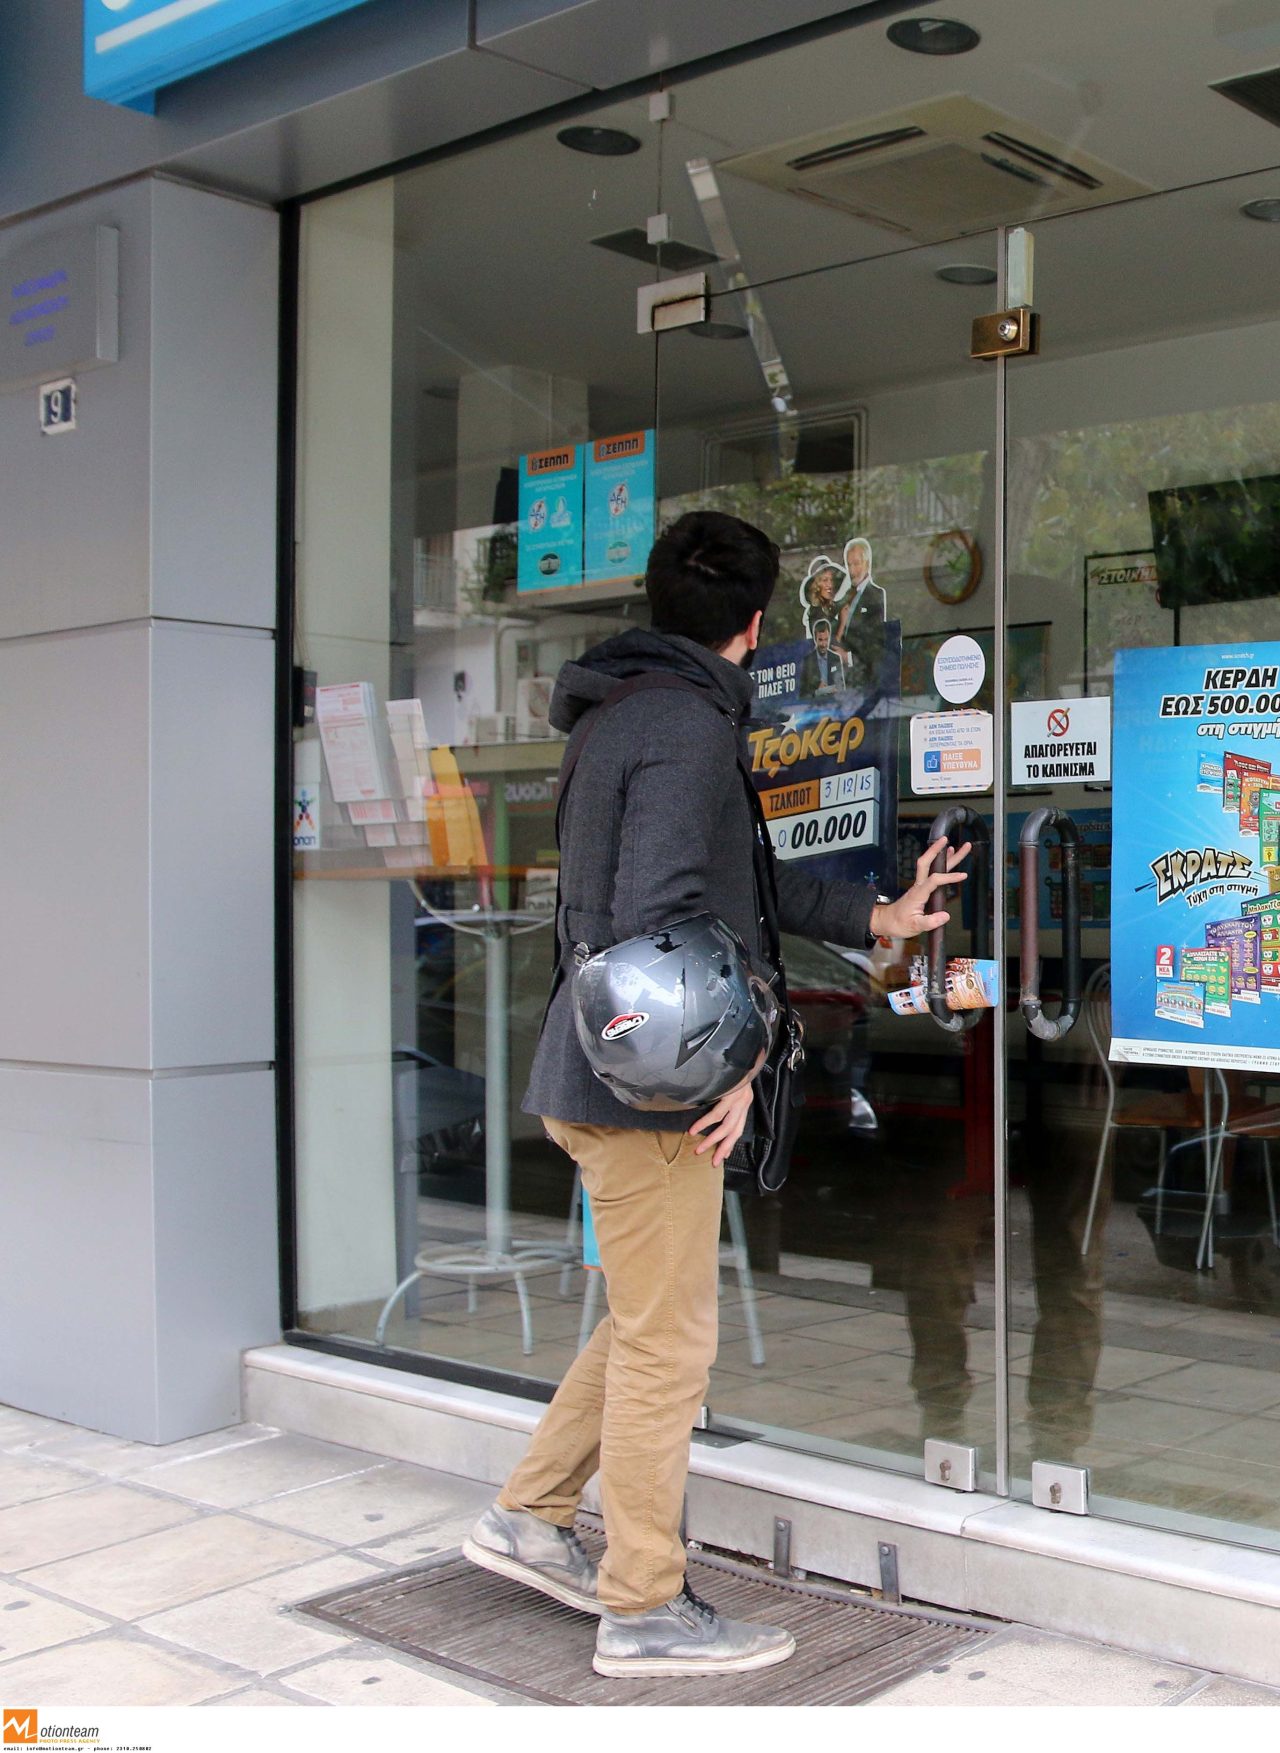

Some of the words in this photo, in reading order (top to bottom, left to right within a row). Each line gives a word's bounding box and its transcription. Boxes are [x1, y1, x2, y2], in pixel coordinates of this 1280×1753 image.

[50, 390, 62, 423] 9
[1099, 565, 1158, 586] ΣΤΟΙΧΗΜ
[757, 670, 774, 684] ΤΟΝ
[776, 662, 796, 680] ΘΕΙΟ
[1203, 666, 1280, 691] ΚΕΡΔΗ
[758, 682, 783, 699] ΠΙΑΣΕ
[785, 678, 796, 693] ΤΟ
[1160, 695, 1205, 717] ΕΩΣ
[1197, 722, 1225, 740] στη
[942, 752, 964, 761] ΠΑΙΞΕ
[1023, 741, 1097, 759] ΑΠΑΓΟΡΕΥΕΤΑΙ
[941, 760, 978, 770] ΥΠΕΥΘΥΝΑ
[1026, 763, 1039, 778] ΤΟ
[1041, 761, 1095, 778] ΚΑΠΝΙΣΜΑ
[769, 786, 813, 813] ΤΖΑΚΠΟΤ
[1187, 891, 1208, 908] Τύχη
[1208, 885, 1225, 898] στη
[1226, 882, 1259, 897] στιγμή
[1159, 947, 1171, 965] 2
[1158, 965, 1170, 973] ΝΕΑ
